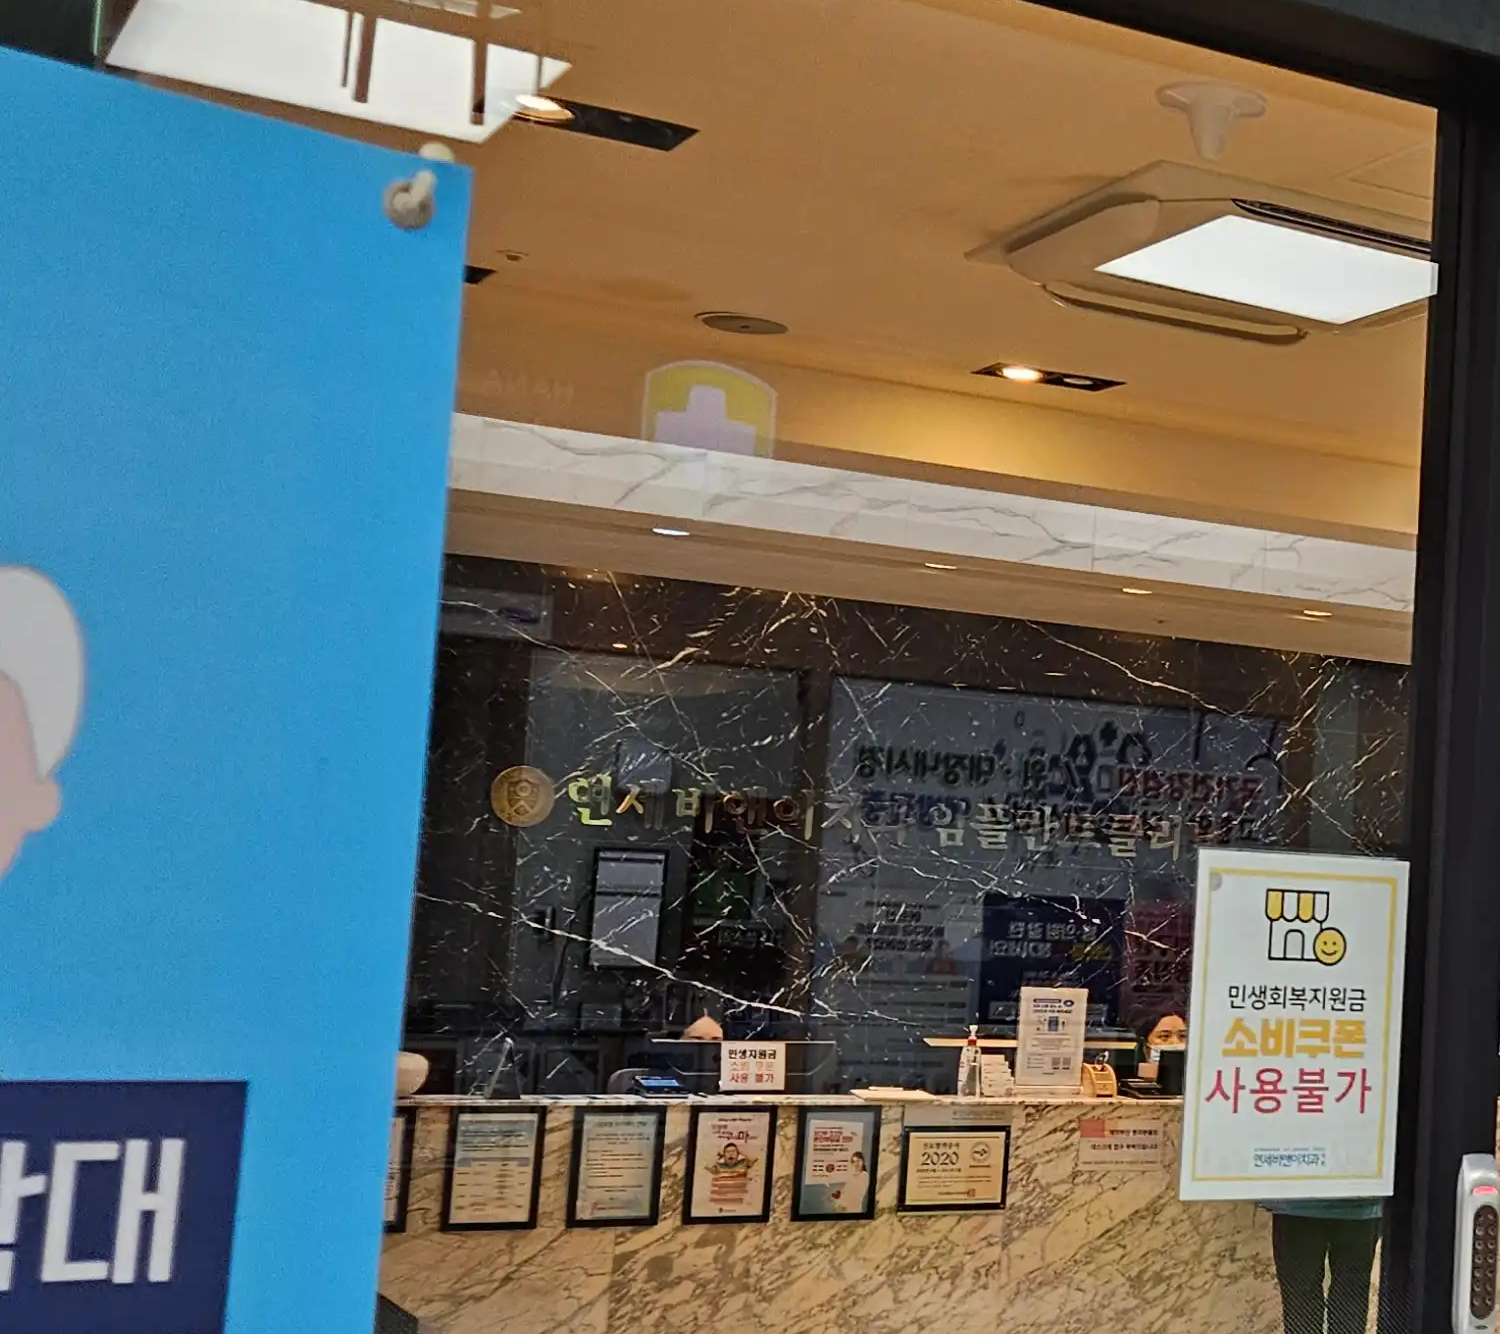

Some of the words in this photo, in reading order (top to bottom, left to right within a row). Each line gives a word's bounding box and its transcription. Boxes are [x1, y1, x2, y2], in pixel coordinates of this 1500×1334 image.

[1227, 983, 1368, 1013] 민생회복지원금
[1221, 1017, 1368, 1059] 소비쿠폰
[1204, 1066, 1373, 1115] 사용불가
[921, 1151, 960, 1166] 2020
